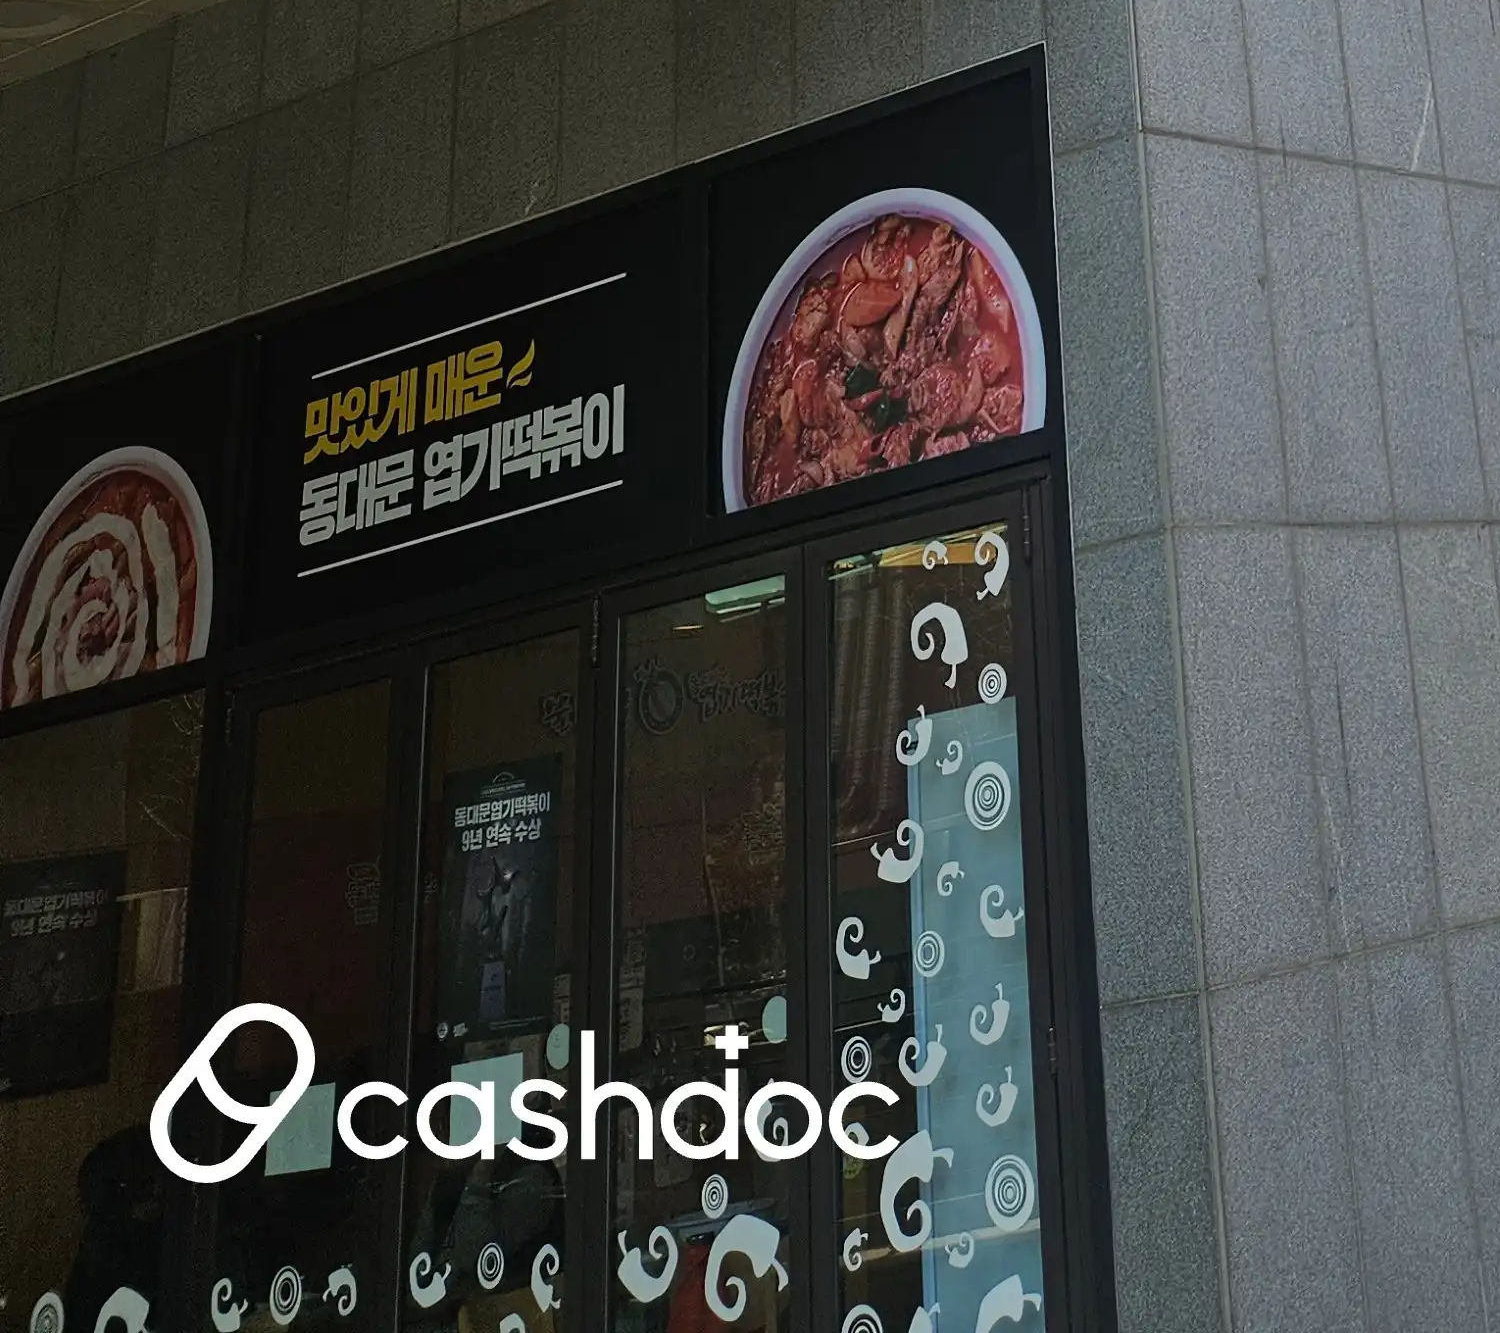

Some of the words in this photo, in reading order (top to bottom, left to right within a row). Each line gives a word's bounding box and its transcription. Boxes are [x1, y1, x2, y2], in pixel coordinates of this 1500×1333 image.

[303, 366, 419, 466] 맛있게
[424, 340, 503, 425] 매운
[299, 448, 414, 547] 동대문
[423, 383, 626, 511] 엽기떡볶이
[453, 791, 551, 828] 동대문엽기떡볶이
[461, 828, 483, 852] 9년
[485, 822, 512, 848] 연속
[514, 817, 542, 845] 수상
